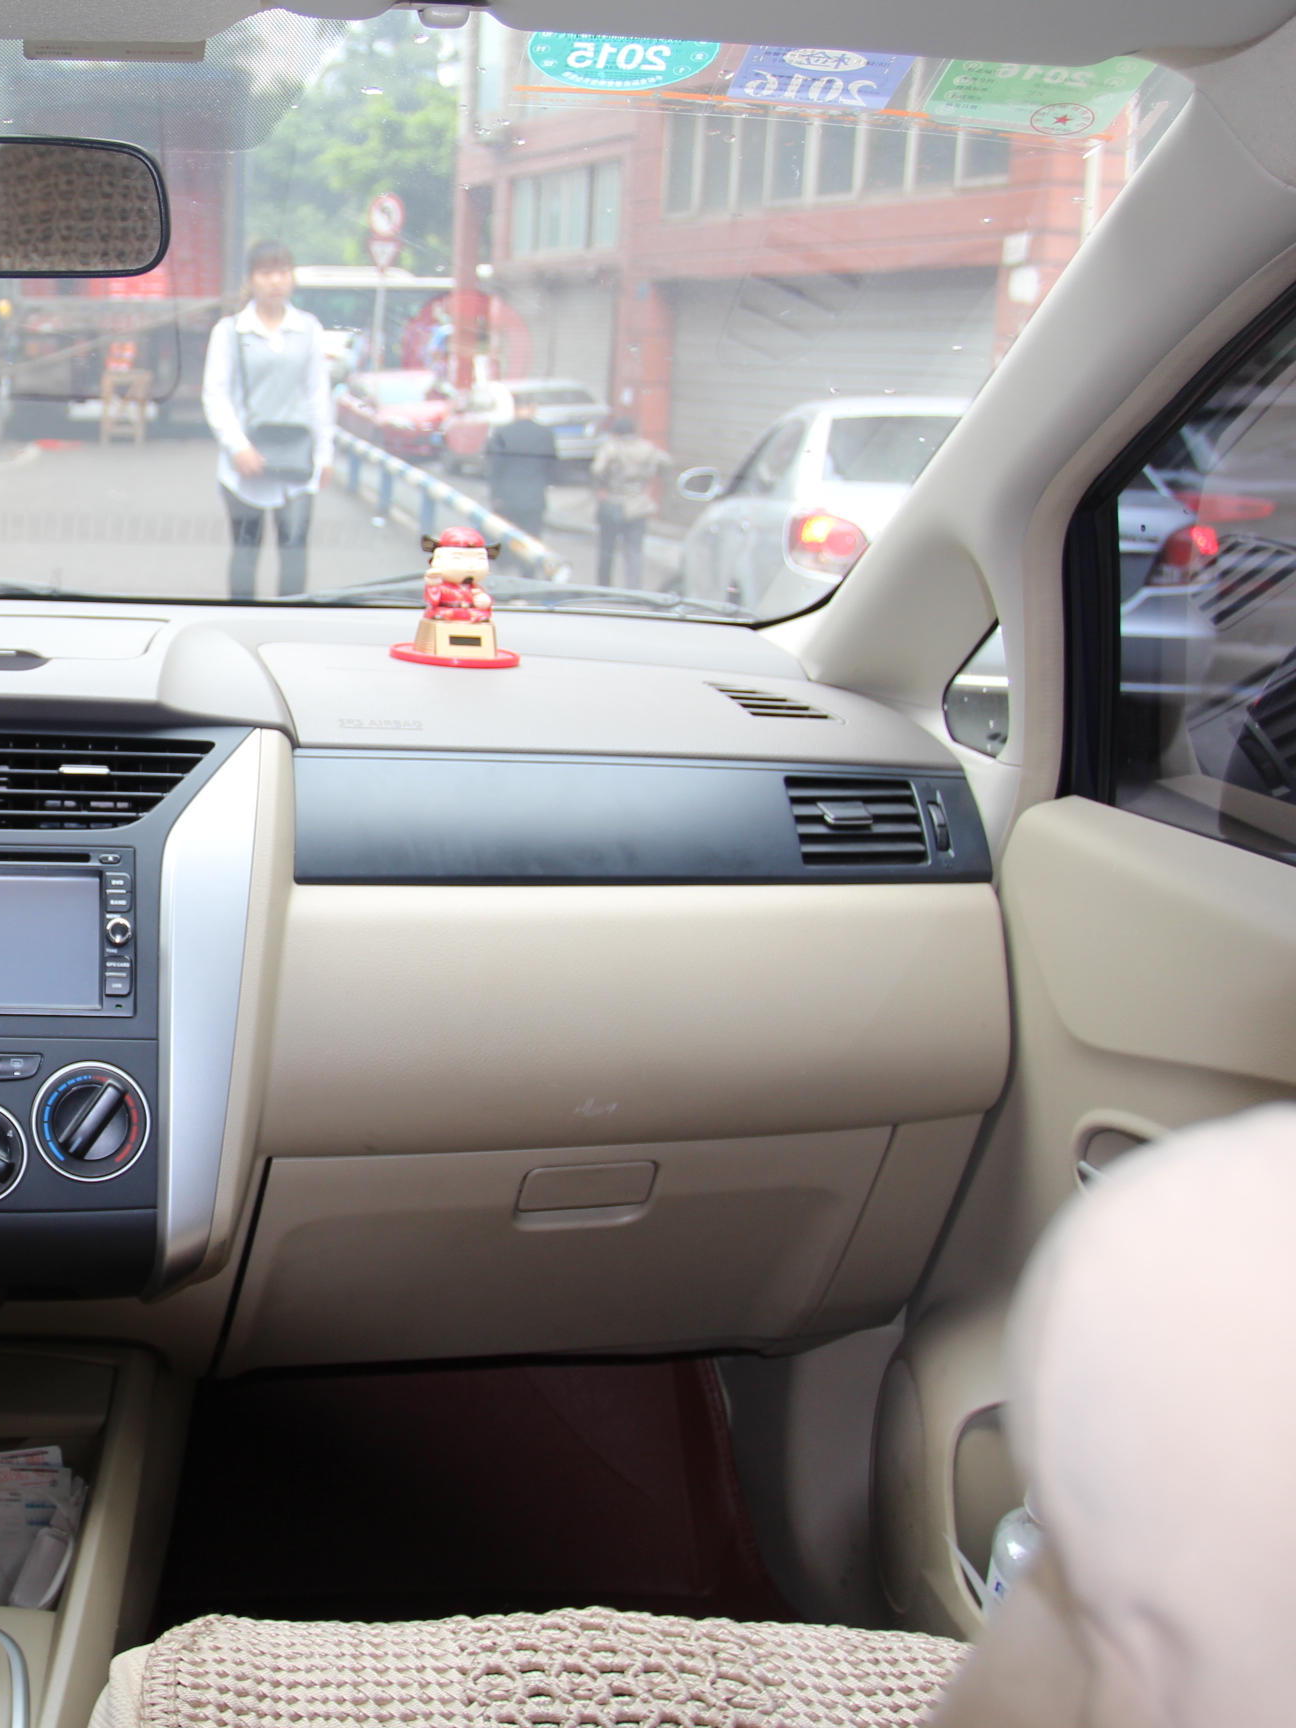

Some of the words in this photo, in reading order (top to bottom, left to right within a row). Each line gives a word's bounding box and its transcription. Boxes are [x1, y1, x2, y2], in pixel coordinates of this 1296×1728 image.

[338, 718, 364, 727] SRS
[368, 719, 422, 728] AIRBAG
[6, 1130, 13, 1138] 4
